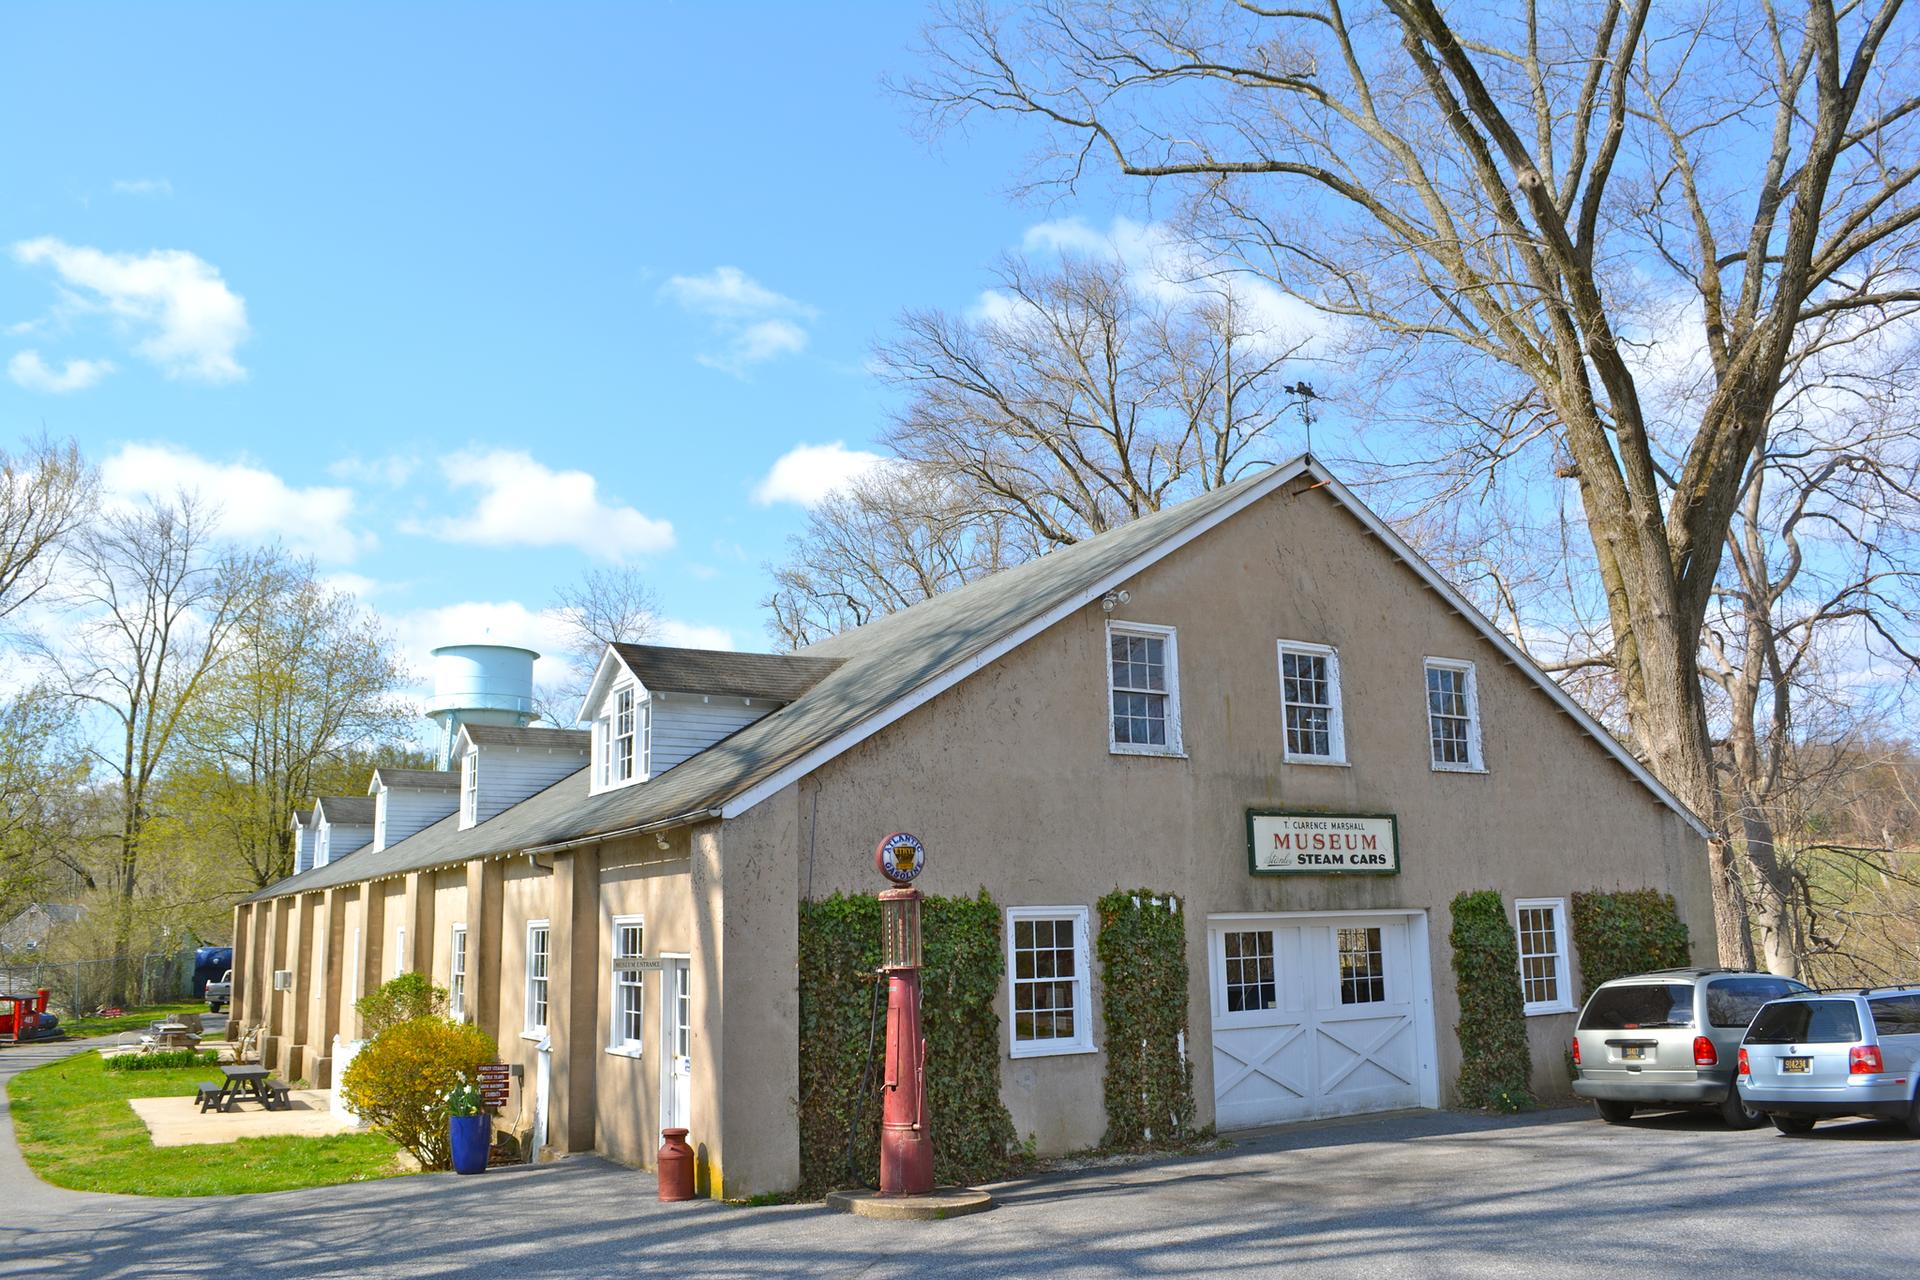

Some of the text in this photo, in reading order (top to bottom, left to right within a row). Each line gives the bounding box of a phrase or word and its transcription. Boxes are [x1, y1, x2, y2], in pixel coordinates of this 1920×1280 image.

[1284, 821, 1365, 831] T. CLARENCE MARSHALL
[884, 835, 922, 854] ATLANTIC
[1273, 833, 1377, 850] MUSEUM
[1297, 853, 1343, 865] STEAM
[1350, 853, 1387, 865] CARS
